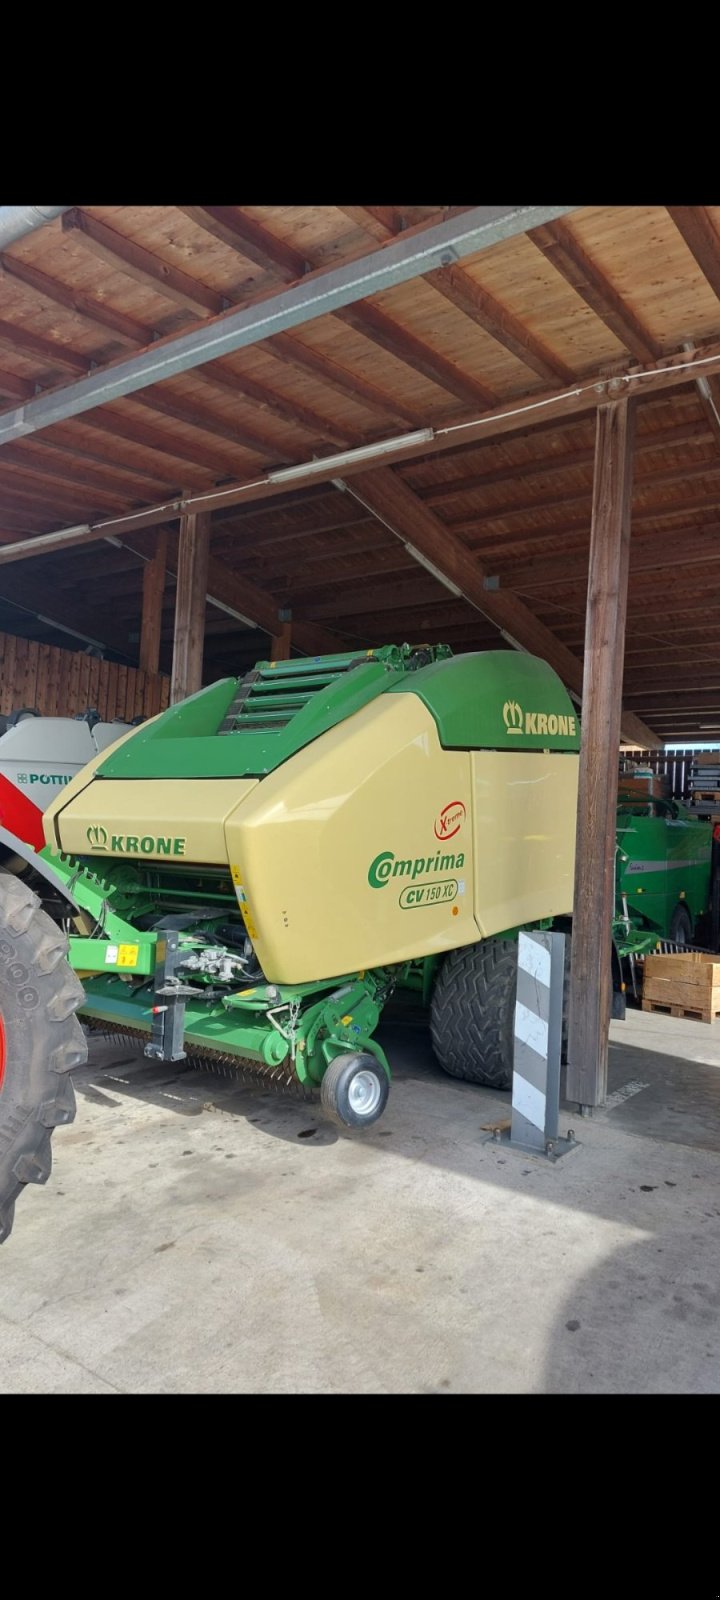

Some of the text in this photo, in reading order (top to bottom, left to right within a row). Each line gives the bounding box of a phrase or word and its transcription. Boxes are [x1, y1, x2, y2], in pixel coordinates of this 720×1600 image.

[525, 712, 576, 736] KRONE
[111, 835, 186, 855] KRONE
[367, 851, 465, 889] Comprima
[406, 883, 454, 903] CV 150 XC
